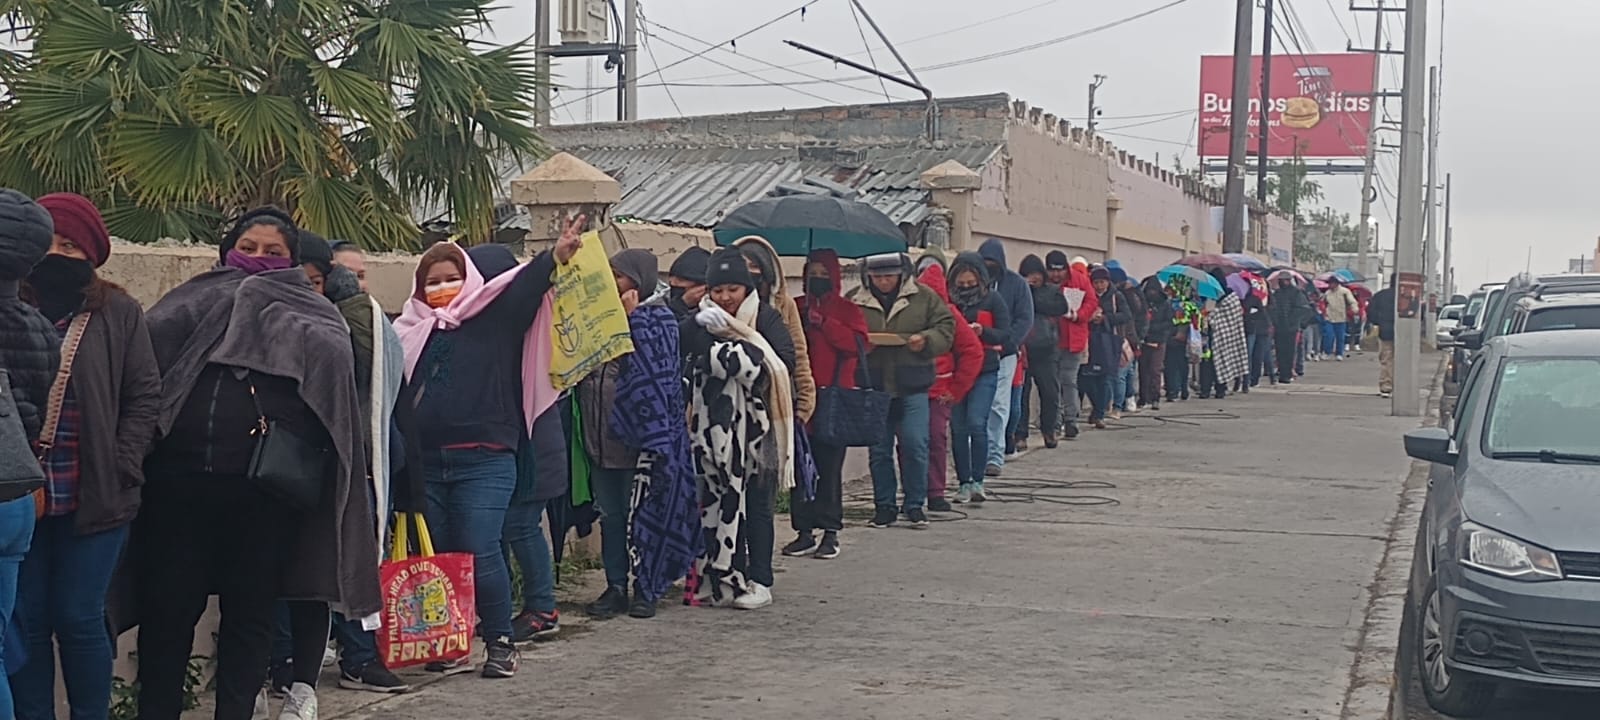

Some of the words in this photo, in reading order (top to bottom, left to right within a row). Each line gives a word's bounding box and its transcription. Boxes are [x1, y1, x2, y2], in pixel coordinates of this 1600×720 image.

[1203, 93, 1287, 113] Bunos
[390, 569, 409, 596] HEAD
[388, 599, 399, 641] FALLING
[388, 642, 430, 662] FOR
[430, 631, 469, 657] YOU
